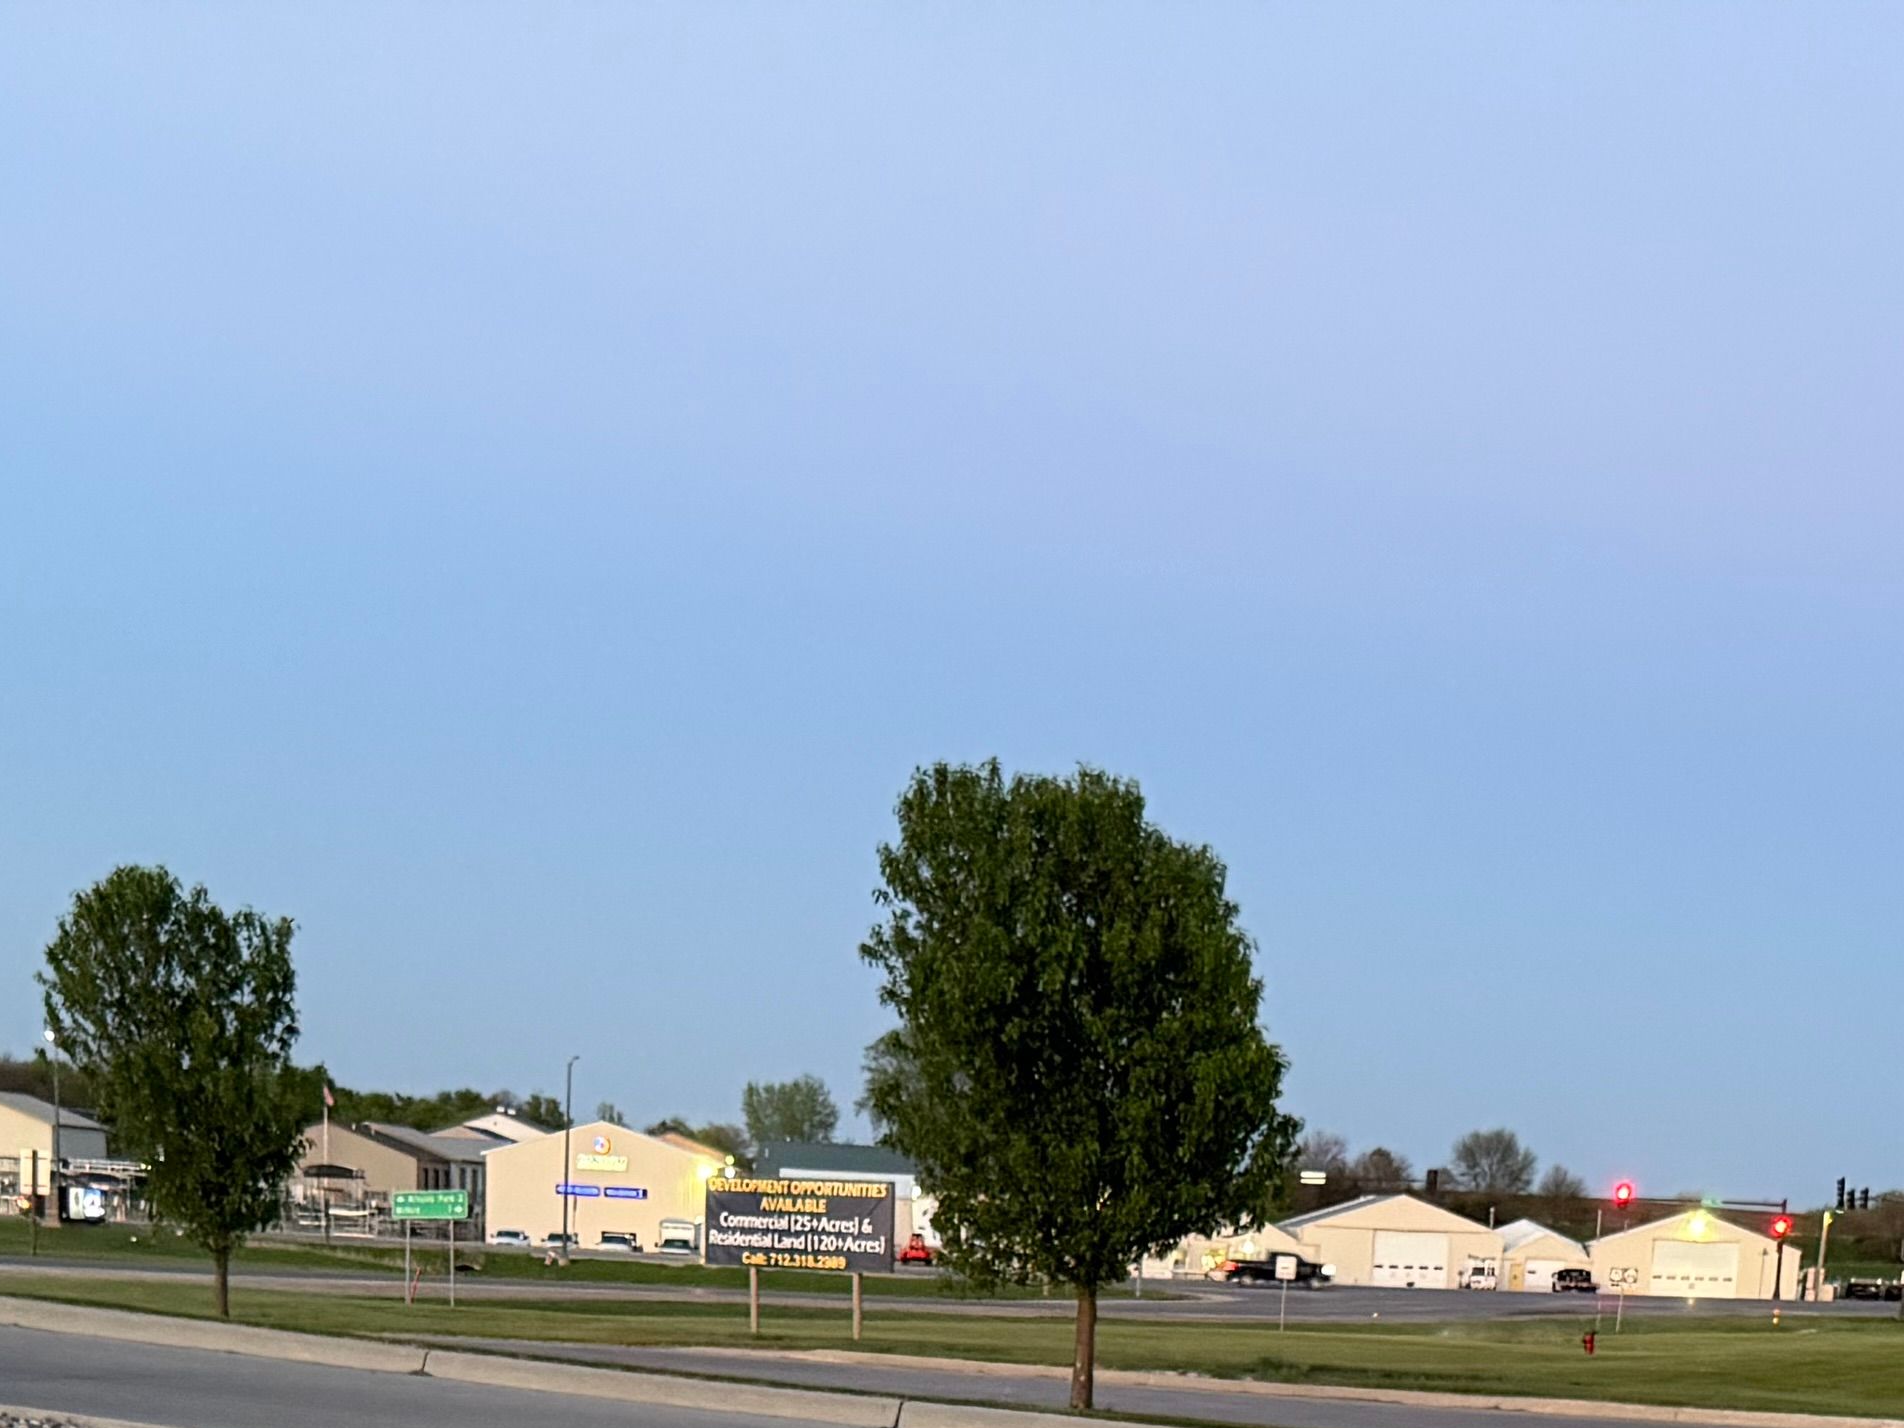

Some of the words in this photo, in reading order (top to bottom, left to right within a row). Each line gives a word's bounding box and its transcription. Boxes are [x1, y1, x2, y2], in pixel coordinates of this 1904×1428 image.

[709, 1177, 789, 1195] DEVELOPMENT
[790, 1181, 887, 1198] OPPORTUNITIES
[760, 1197, 827, 1213] AVAILABLE
[719, 1211, 789, 1230] Commercial
[861, 1218, 873, 1234] &
[709, 1229, 772, 1249] Residential
[773, 1233, 805, 1250] Land
